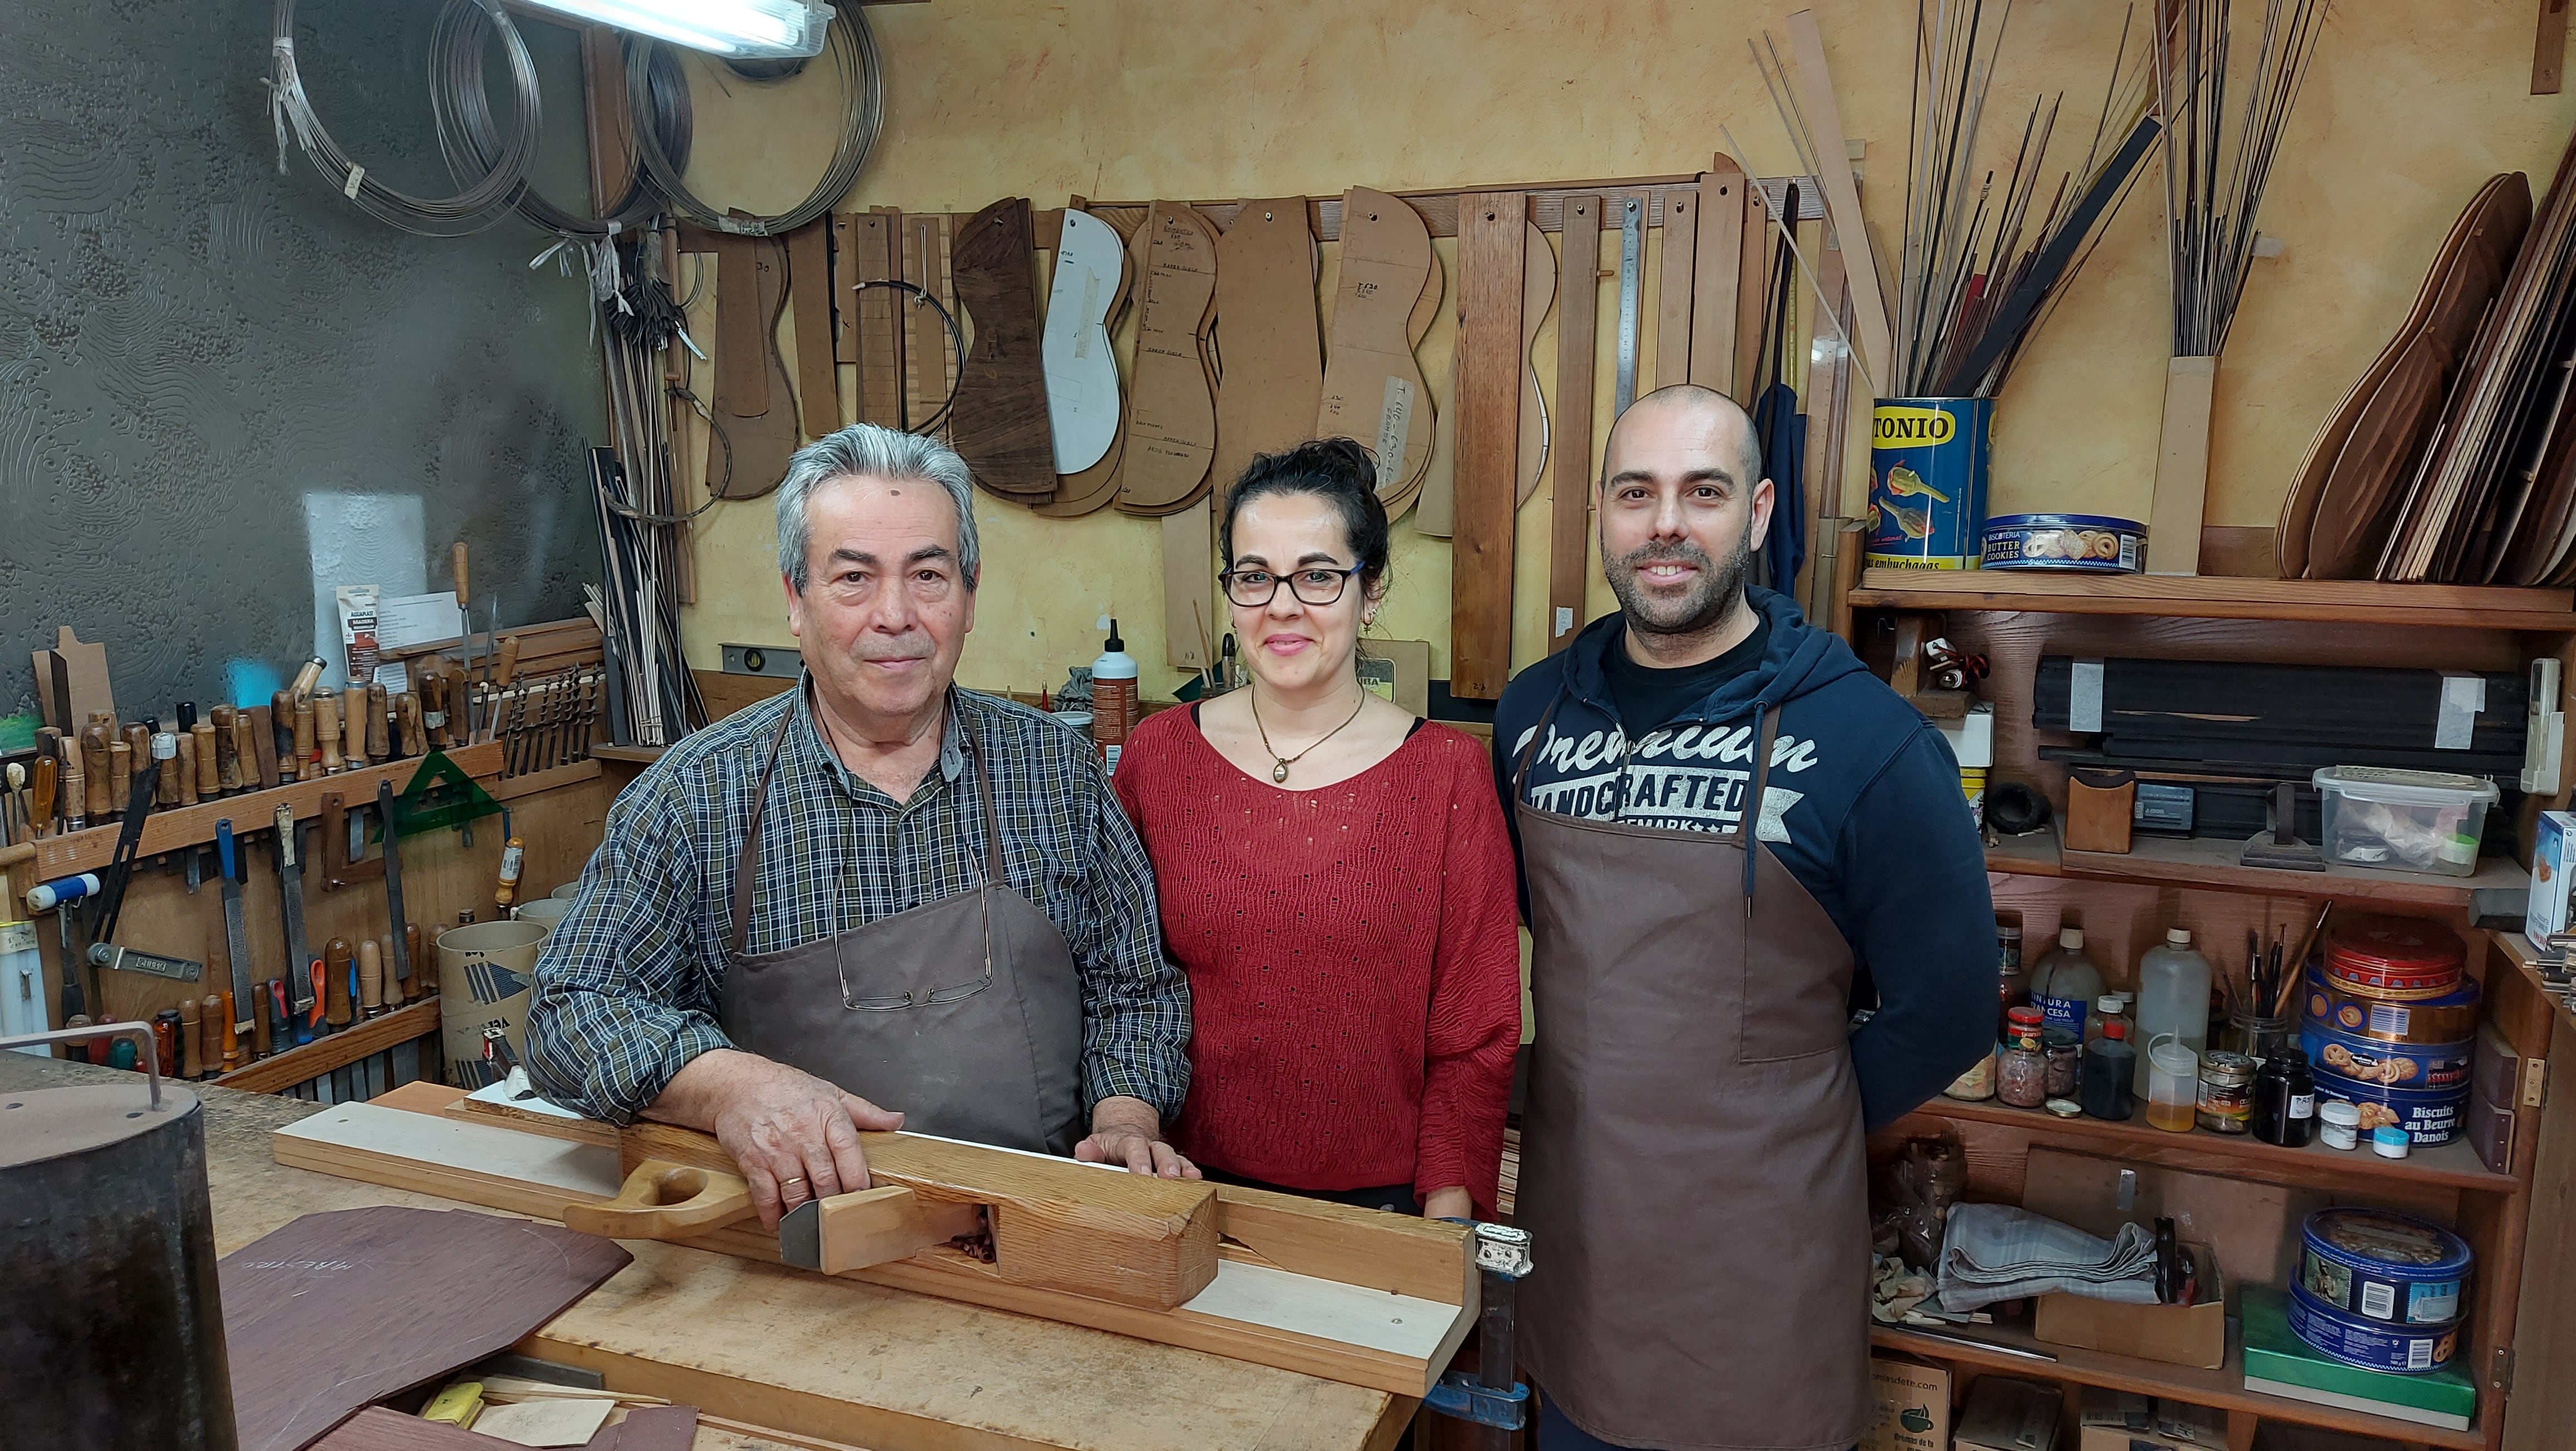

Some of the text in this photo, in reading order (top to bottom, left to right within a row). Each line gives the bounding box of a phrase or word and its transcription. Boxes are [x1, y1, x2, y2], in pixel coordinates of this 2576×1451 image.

[1987, 541, 2020, 553] BUTTER
[1987, 551, 2019, 561] COOKIES
[2411, 1105, 2455, 1119] Biscuits
[2404, 1118, 2456, 1131] au Beurre
[2413, 1131, 2450, 1143] Danois
